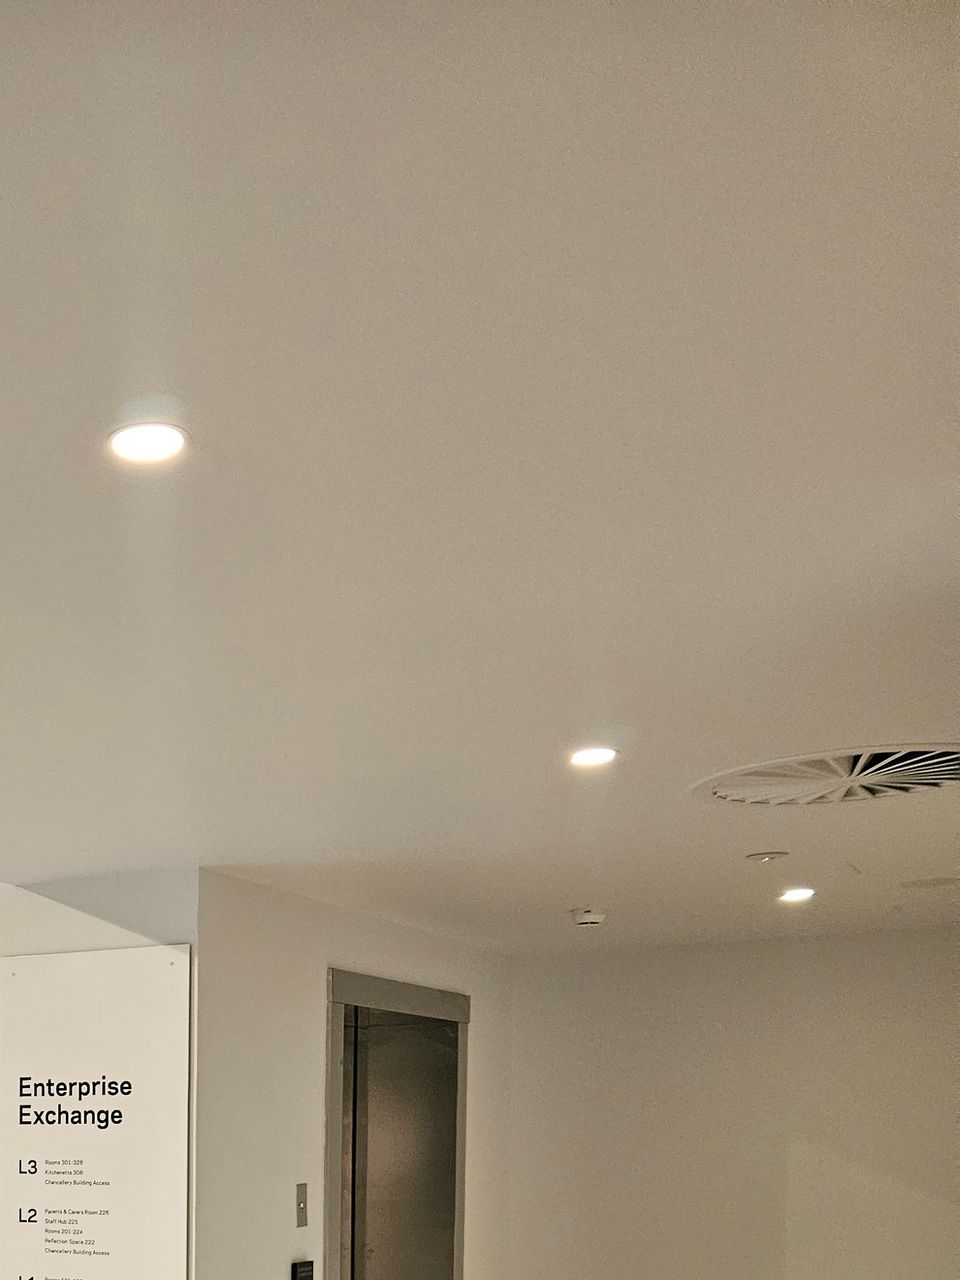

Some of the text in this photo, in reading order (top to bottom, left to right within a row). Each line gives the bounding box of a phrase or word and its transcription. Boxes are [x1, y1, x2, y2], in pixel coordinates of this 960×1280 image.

[19, 1075, 132, 1101] Enterprise
[19, 1104, 123, 1129] Exchange
[19, 1160, 38, 1174] L3
[19, 1208, 38, 1223] L2
